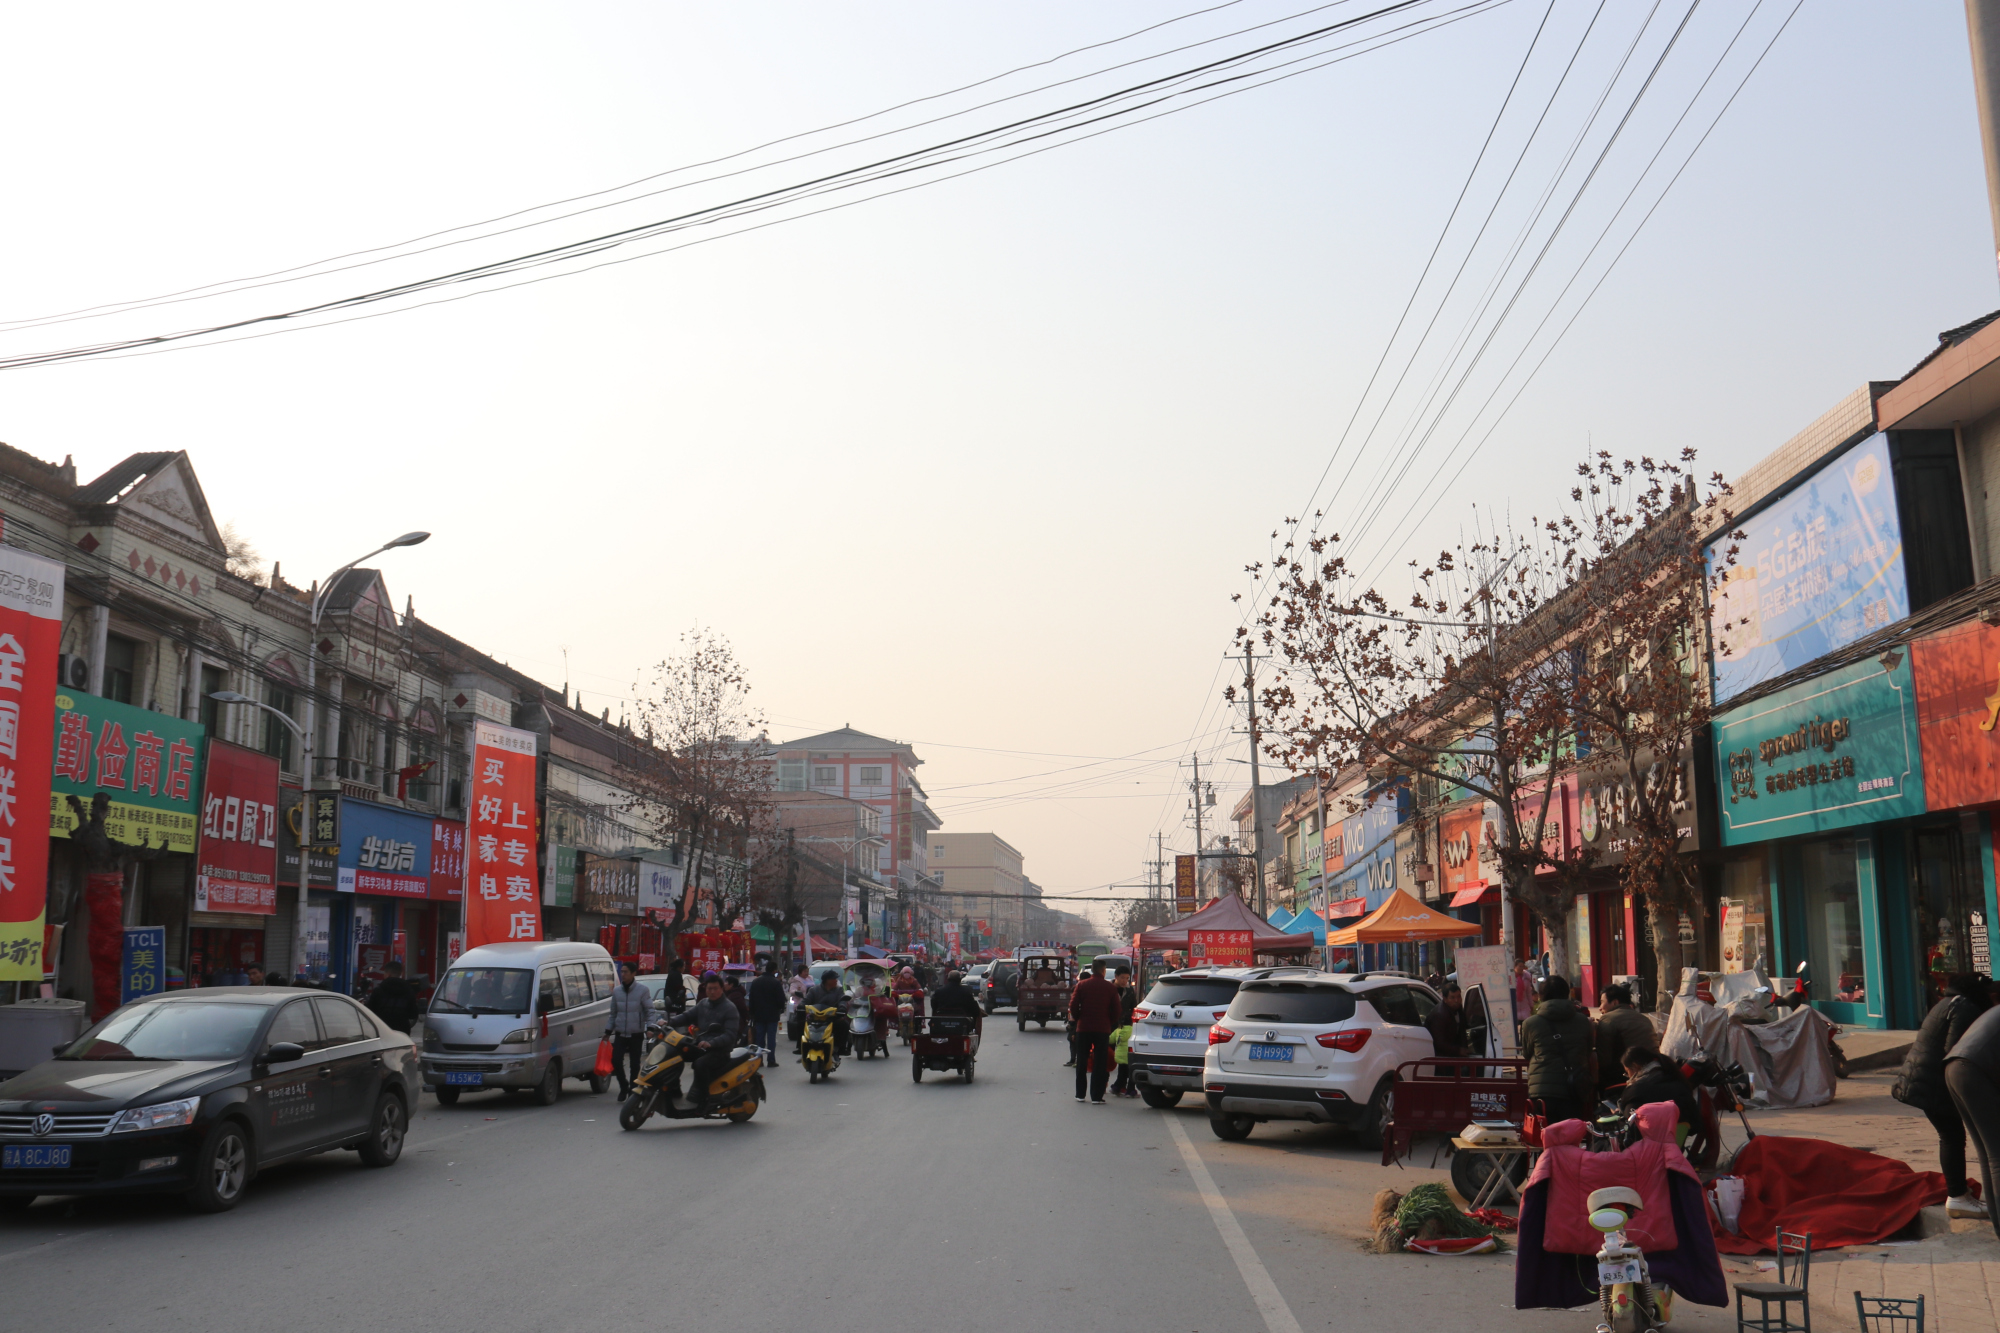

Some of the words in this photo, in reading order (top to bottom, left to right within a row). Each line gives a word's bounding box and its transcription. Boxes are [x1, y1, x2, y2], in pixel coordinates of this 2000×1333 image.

[1757, 515, 1826, 587] 5G品质
[54, 710, 196, 802] 勤俭商店
[1759, 722, 1808, 767] sprout
[1809, 714, 1850, 753] tiger
[204, 791, 275, 849] 红日厨卫
[317, 798, 335, 840] 宾馆
[477, 757, 505, 901] 买好家电
[1372, 807, 1388, 829] vivo
[358, 835, 417, 872] 步步高
[442, 827, 463, 853] 香辣
[1343, 820, 1365, 857] vivo
[433, 854, 465, 879] 土豆片夹
[502, 802, 537, 938] 上专卖店
[1178, 856, 1193, 896] 龙悦宾馆
[1366, 850, 1395, 892] vivo
[128, 933, 159, 947] TCL
[1193, 932, 1251, 944] 好日子蛋糕
[1206, 947, 1251, 956] 18729367601
[130, 949, 156, 1000] 美的
[705, 950, 721, 970] 香辣
